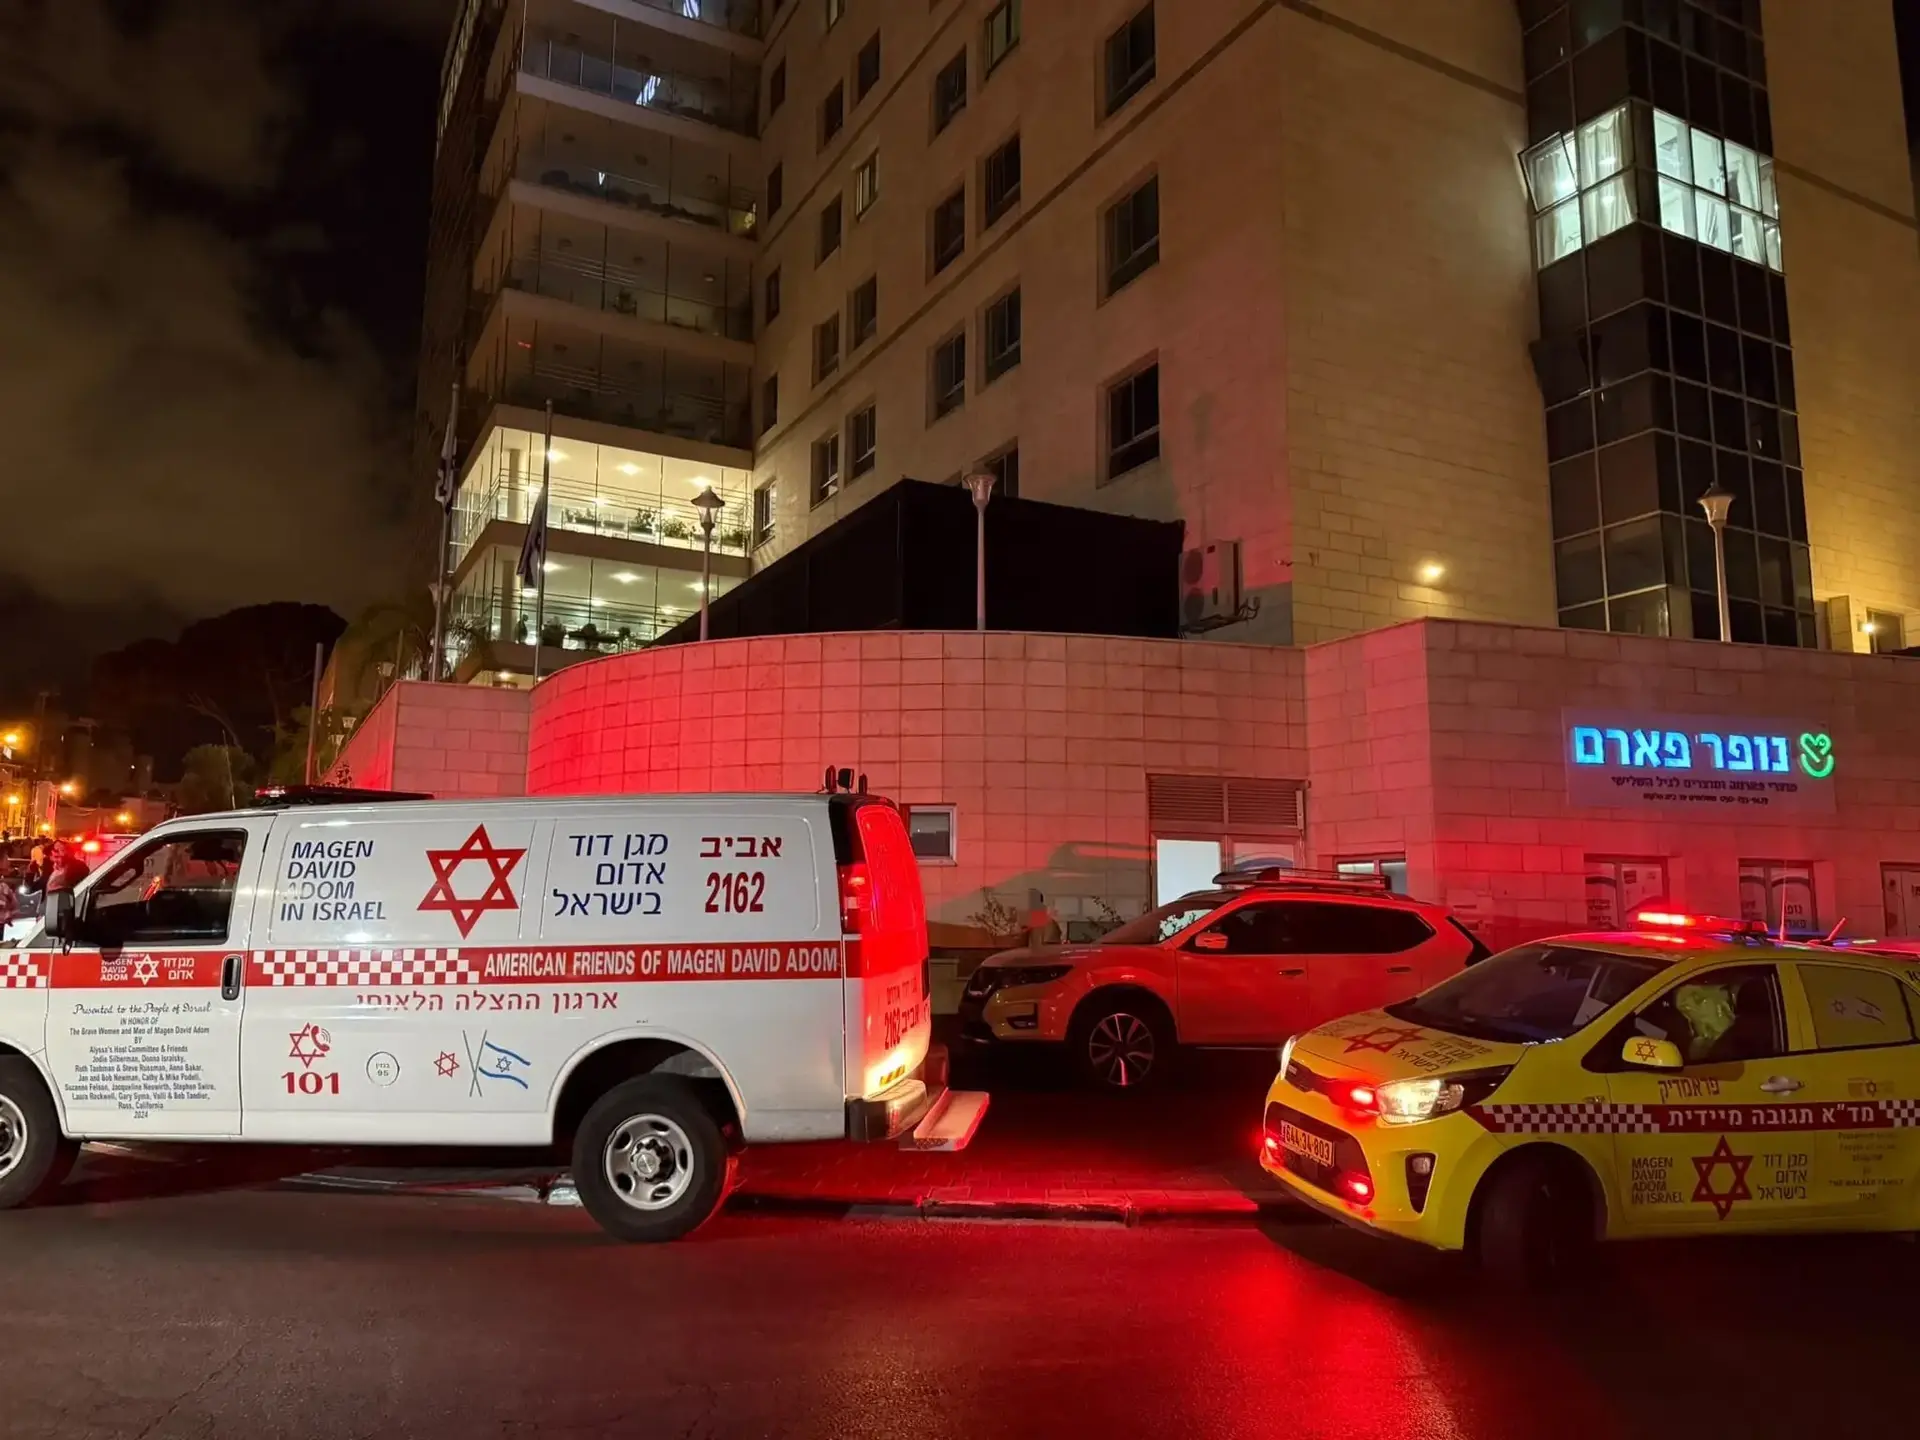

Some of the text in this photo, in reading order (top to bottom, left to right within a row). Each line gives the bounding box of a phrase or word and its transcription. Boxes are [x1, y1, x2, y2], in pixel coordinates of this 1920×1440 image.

[1572, 726, 1790, 773] נופר פארם
[291, 840, 374, 859] MAGEN
[569, 833, 668, 857] מגן דוד
[700, 836, 782, 858] אביב
[287, 861, 356, 880] DAVID
[596, 862, 666, 885] אדום
[705, 871, 765, 913] 2162
[553, 889, 662, 917] בישראל
[280, 901, 387, 921] IN ISRAEL
[161, 957, 195, 969] מגן דוד
[484, 947, 837, 977] AMERICAN FRIENDS OF MAGEN DAVID ADOM
[100, 973, 128, 981] ADOM
[101, 966, 127, 974] DAVID
[168, 970, 194, 980] אדום
[456, 990, 540, 1010] ההצלה
[553, 992, 618, 1013] ארגון
[117, 1005, 127, 1013] to
[129, 1005, 142, 1013] the
[172, 1004, 180, 1014] of
[69, 1025, 210, 1036] The Brave Women and Men of Magen David Adom
[134, 1036, 143, 1044] BY
[161, 1045, 166, 1053] &
[167, 1045, 188, 1053] Friends
[281, 1071, 340, 1095] 101
[135, 1101, 164, 1109] California
[1667, 1109, 1743, 1127] מיידית
[1752, 1107, 1814, 1126] תגובה
[1631, 1157, 1673, 1169] MAGEN
[1763, 1153, 1808, 1167] מגן דוד
[1632, 1169, 1667, 1180] DAVID
[1776, 1170, 1807, 1184] אדום
[1632, 1181, 1667, 1192] ADOM
[1757, 1185, 1807, 1200] בישראל
[1632, 1191, 1684, 1204] IN ISRAEL
